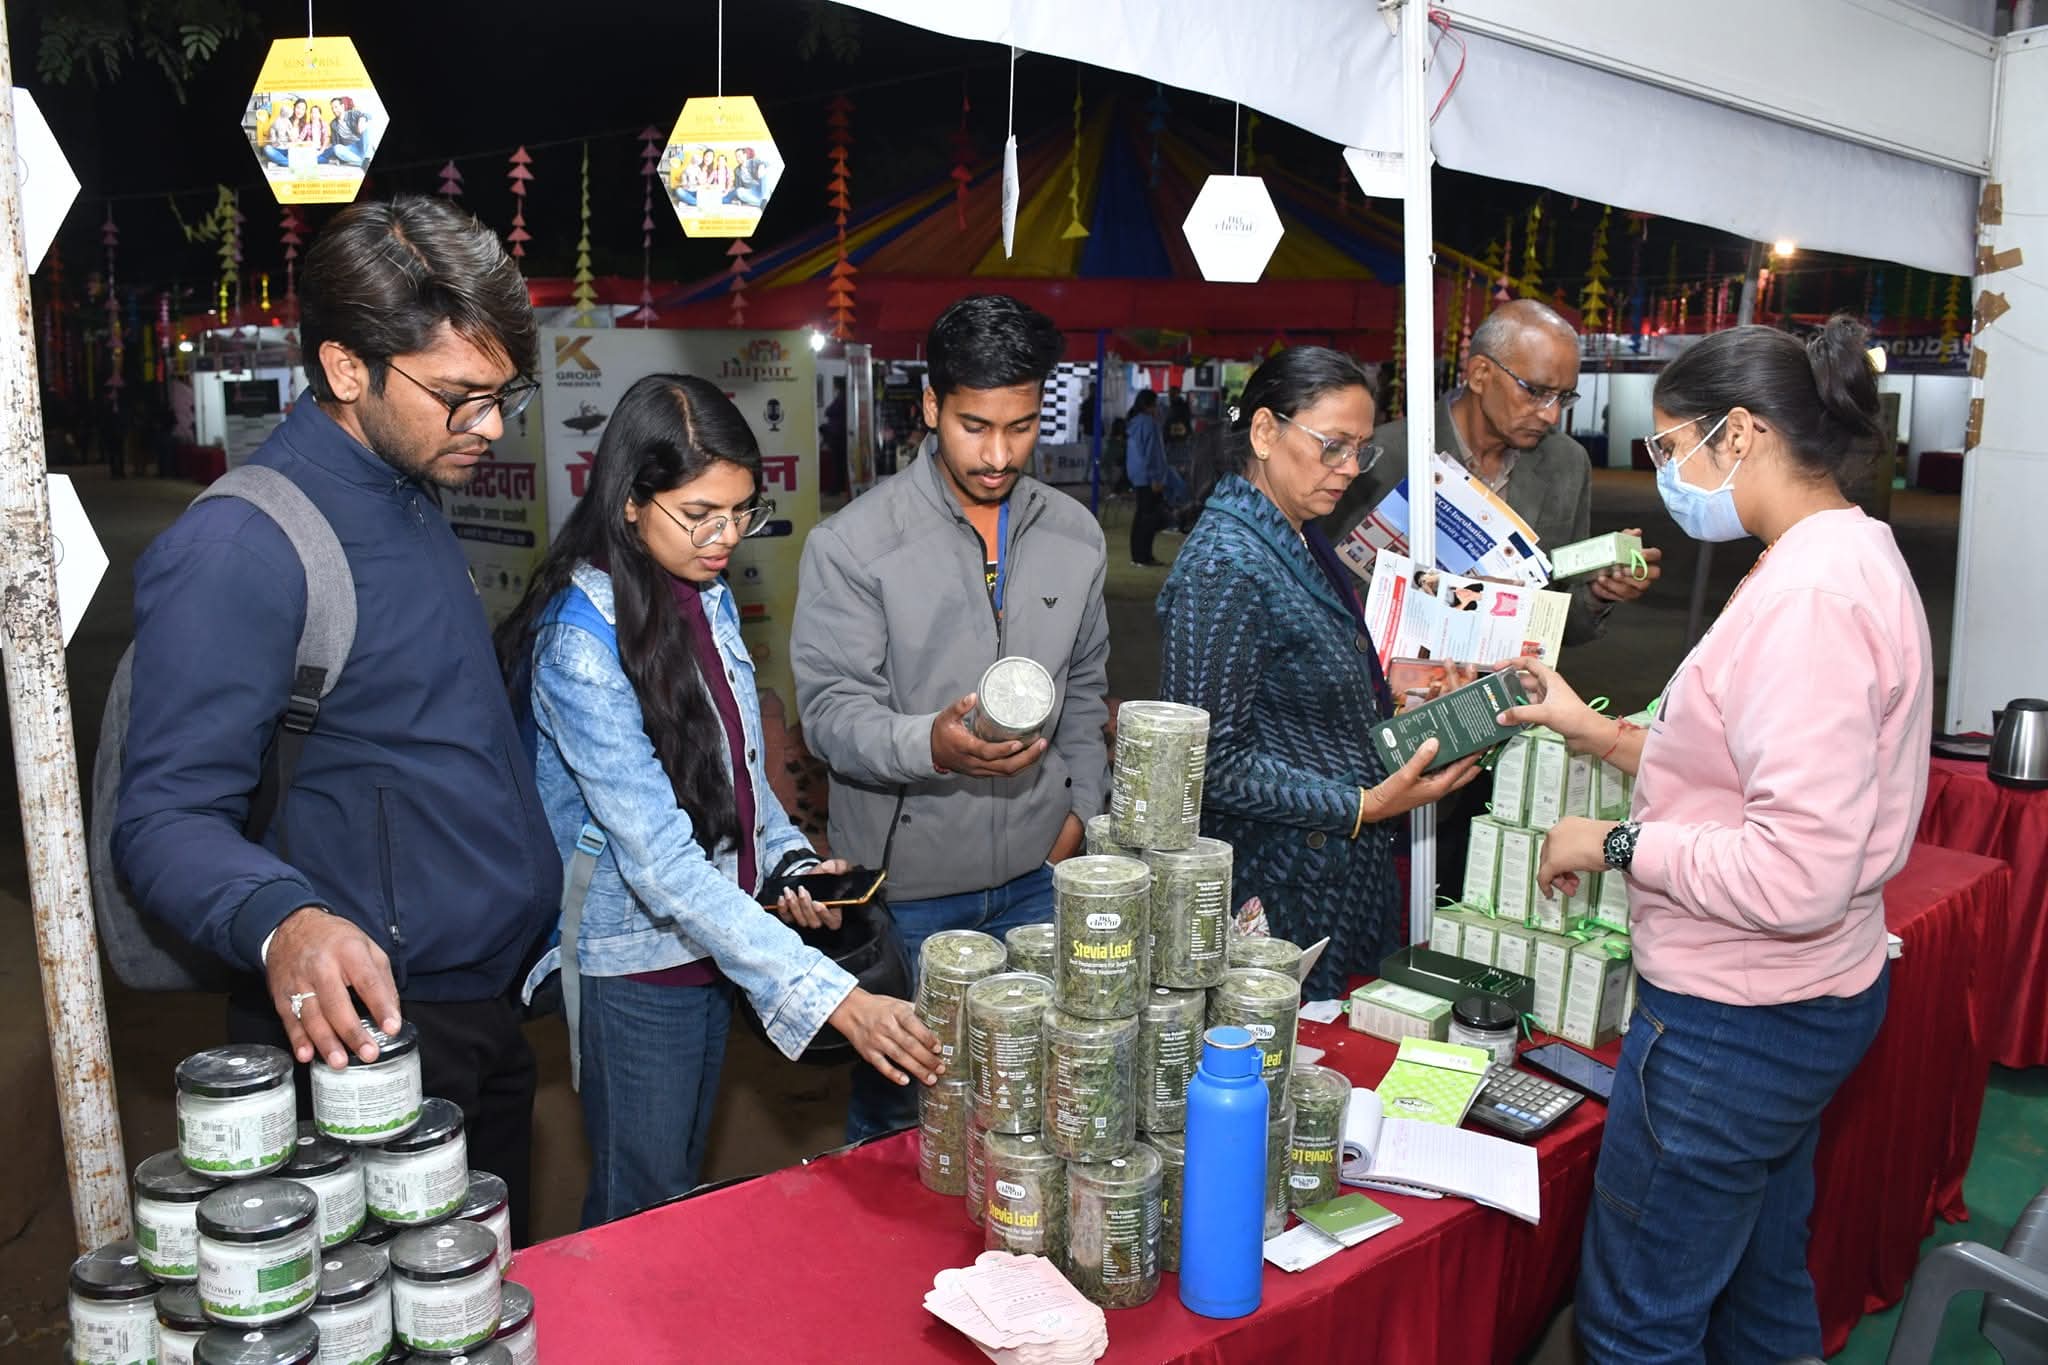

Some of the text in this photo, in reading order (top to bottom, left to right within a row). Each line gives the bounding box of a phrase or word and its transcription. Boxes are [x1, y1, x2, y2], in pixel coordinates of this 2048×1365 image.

[555, 371, 602, 380] GROUP
[1073, 939, 1133, 959] Stevia Leaf
[1263, 1049, 1283, 1067] Leaf
[1304, 1148, 1335, 1165] Stevia
[1014, 1210, 1039, 1228] Leaf
[206, 1280, 241, 1296] Powder
